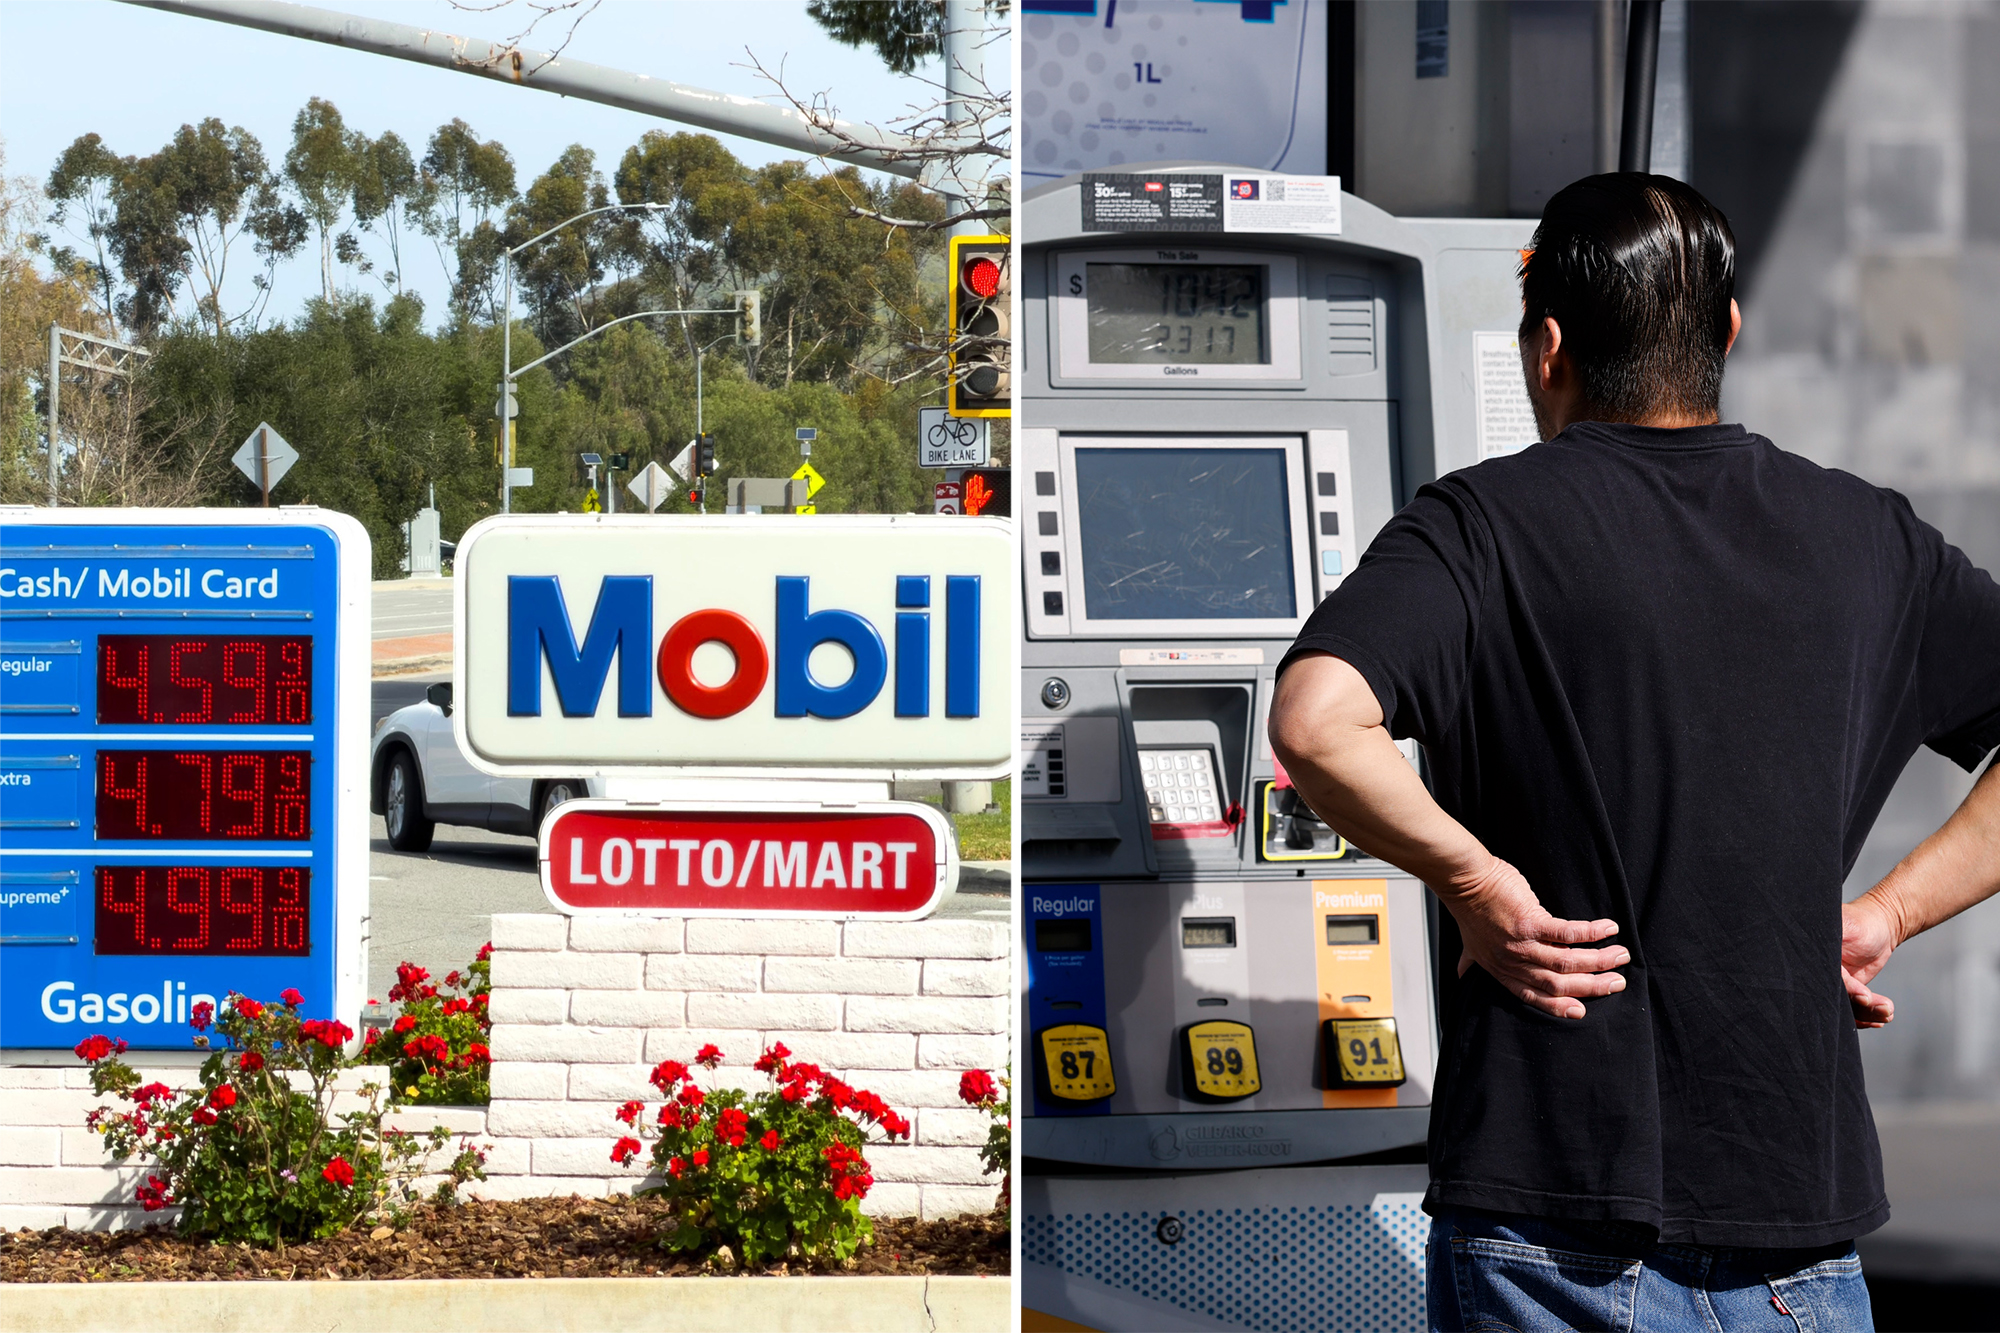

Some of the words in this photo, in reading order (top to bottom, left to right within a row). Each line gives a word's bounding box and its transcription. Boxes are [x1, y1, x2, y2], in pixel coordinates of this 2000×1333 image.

[1157, 251, 1176, 260] This
[1179, 251, 1198, 261] Sale
[1070, 273, 1082, 296] $
[1163, 366, 1198, 376] Gallons
[928, 450, 949, 462] BIKE
[952, 449, 977, 462] LANE
[0, 567, 89, 599] Cash/
[98, 567, 191, 599] Mobil
[201, 567, 279, 599] Card
[507, 574, 981, 720] Mobil
[0, 656, 52, 676] egular
[105, 641, 266, 723] 4.59
[0, 772, 31, 786] xtra
[104, 755, 265, 836] 4.79
[569, 836, 917, 890] LOTTO/MART
[103, 868, 264, 949] 4.99
[1032, 896, 1095, 917] Regular
[1192, 894, 1224, 910] Plus
[1315, 891, 1384, 908] Premium
[41, 979, 233, 1024] Gasolin
[1060, 1050, 1096, 1079] 87
[1206, 1047, 1244, 1076] 89
[1349, 1037, 1389, 1067] 91
[1185, 1124, 1265, 1140] GILBARCO
